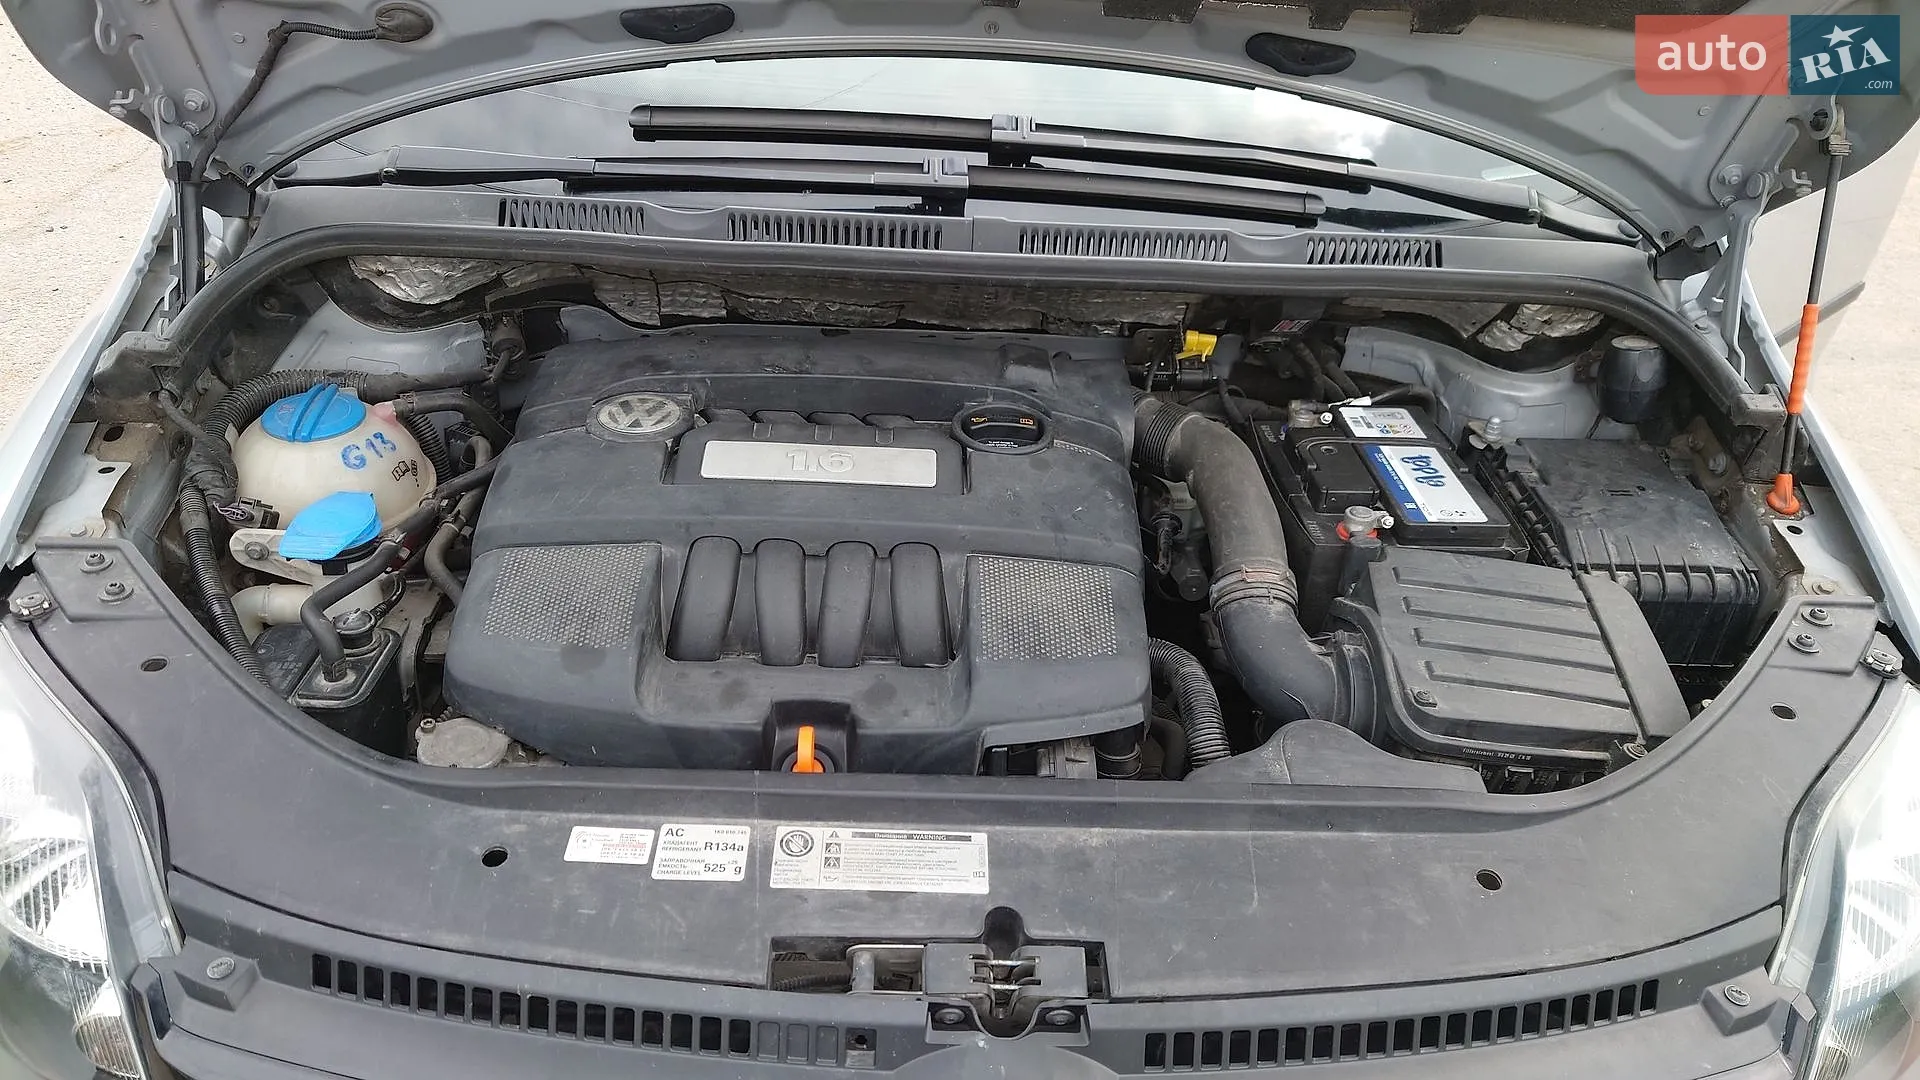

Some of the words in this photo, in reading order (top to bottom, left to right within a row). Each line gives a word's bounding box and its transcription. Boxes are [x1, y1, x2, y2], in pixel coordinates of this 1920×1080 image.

[787, 449, 855, 473] 1.6
[664, 827, 685, 837] AC
[704, 841, 744, 852] R134a
[703, 863, 726, 873] 525
[734, 865, 742, 875] g
